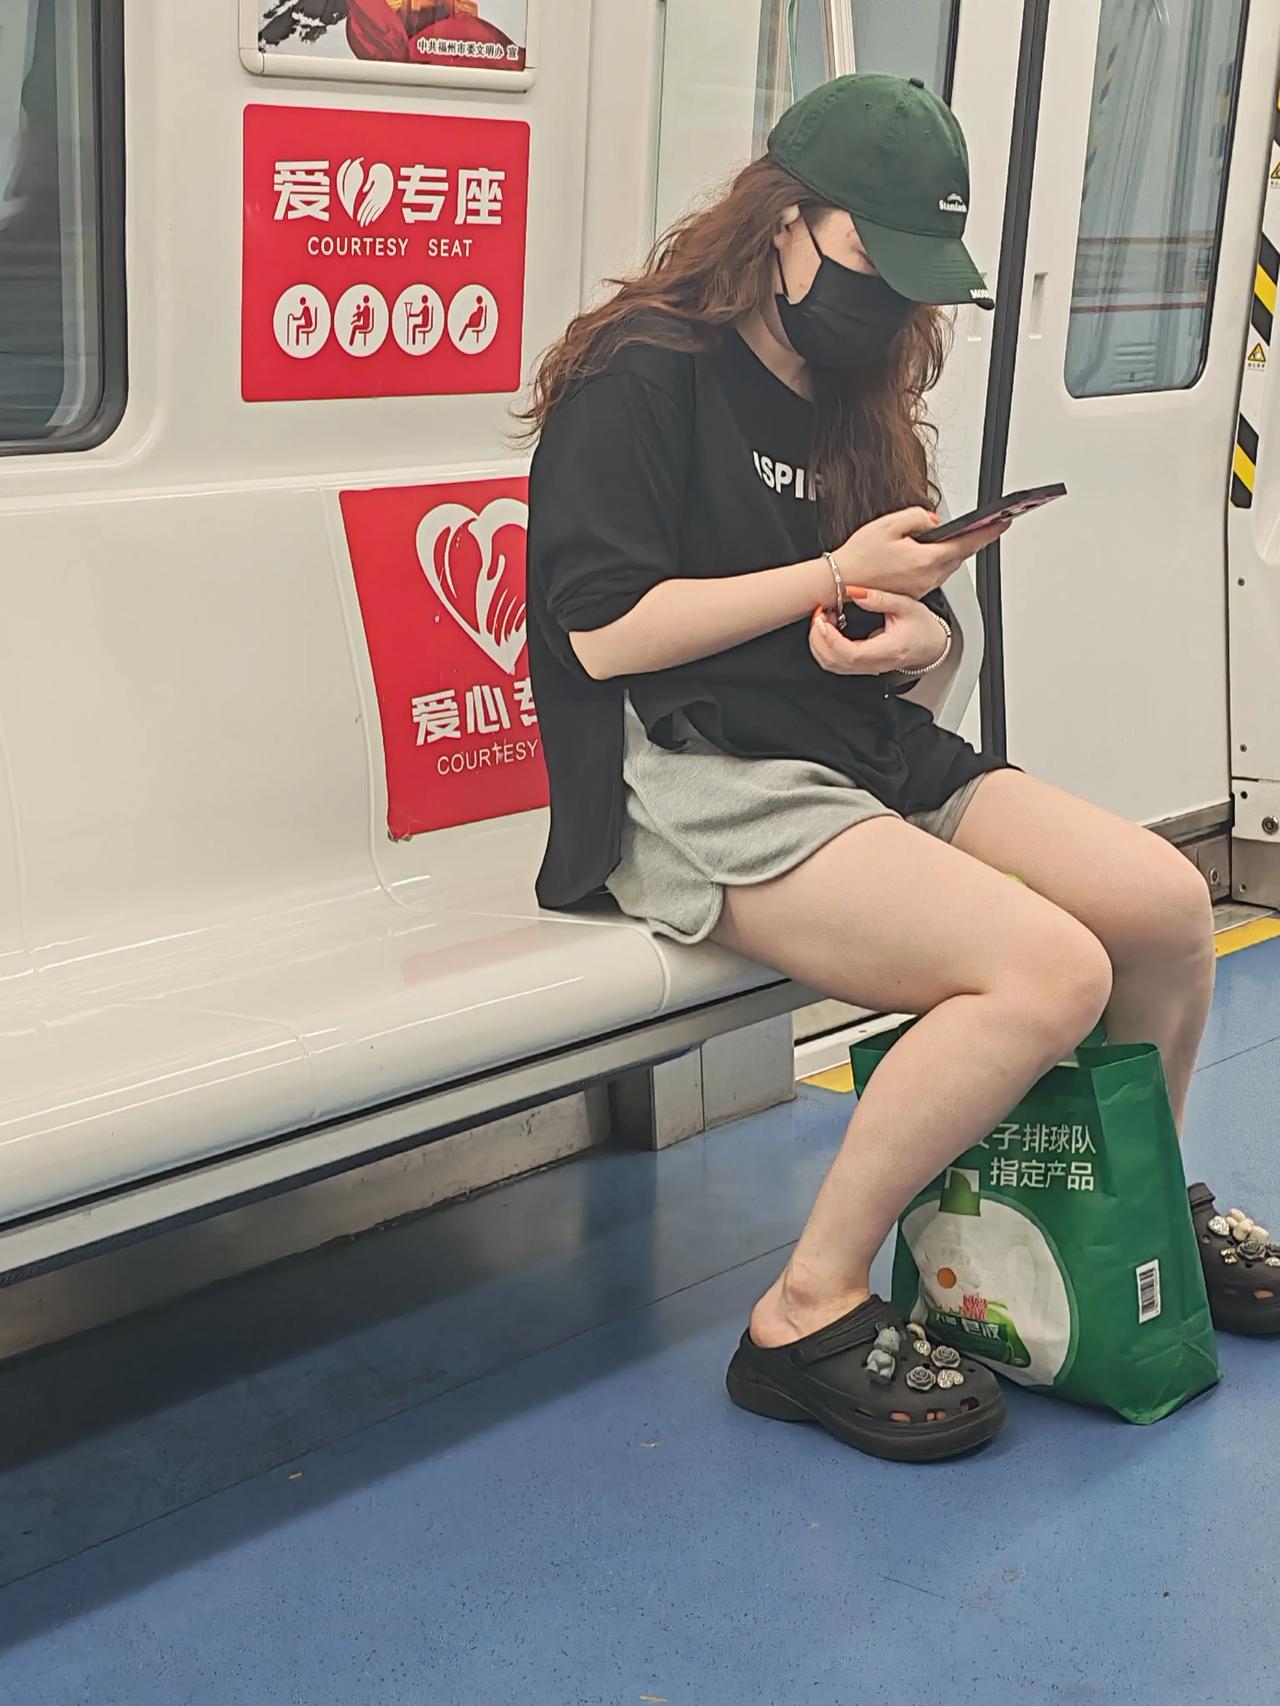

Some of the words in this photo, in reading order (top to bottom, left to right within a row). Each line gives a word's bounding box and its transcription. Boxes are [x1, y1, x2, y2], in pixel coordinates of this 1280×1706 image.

[417, 37, 504, 59] 中共福州市委文明办
[507, 44, 519, 60] 宣
[307, 236, 409, 257] COURTESY
[428, 238, 473, 257] SEAT
[437, 739, 539, 775] COURTESY
[981, 1123, 1097, 1154] 子排球队
[989, 1157, 1095, 1191] 指定产品
